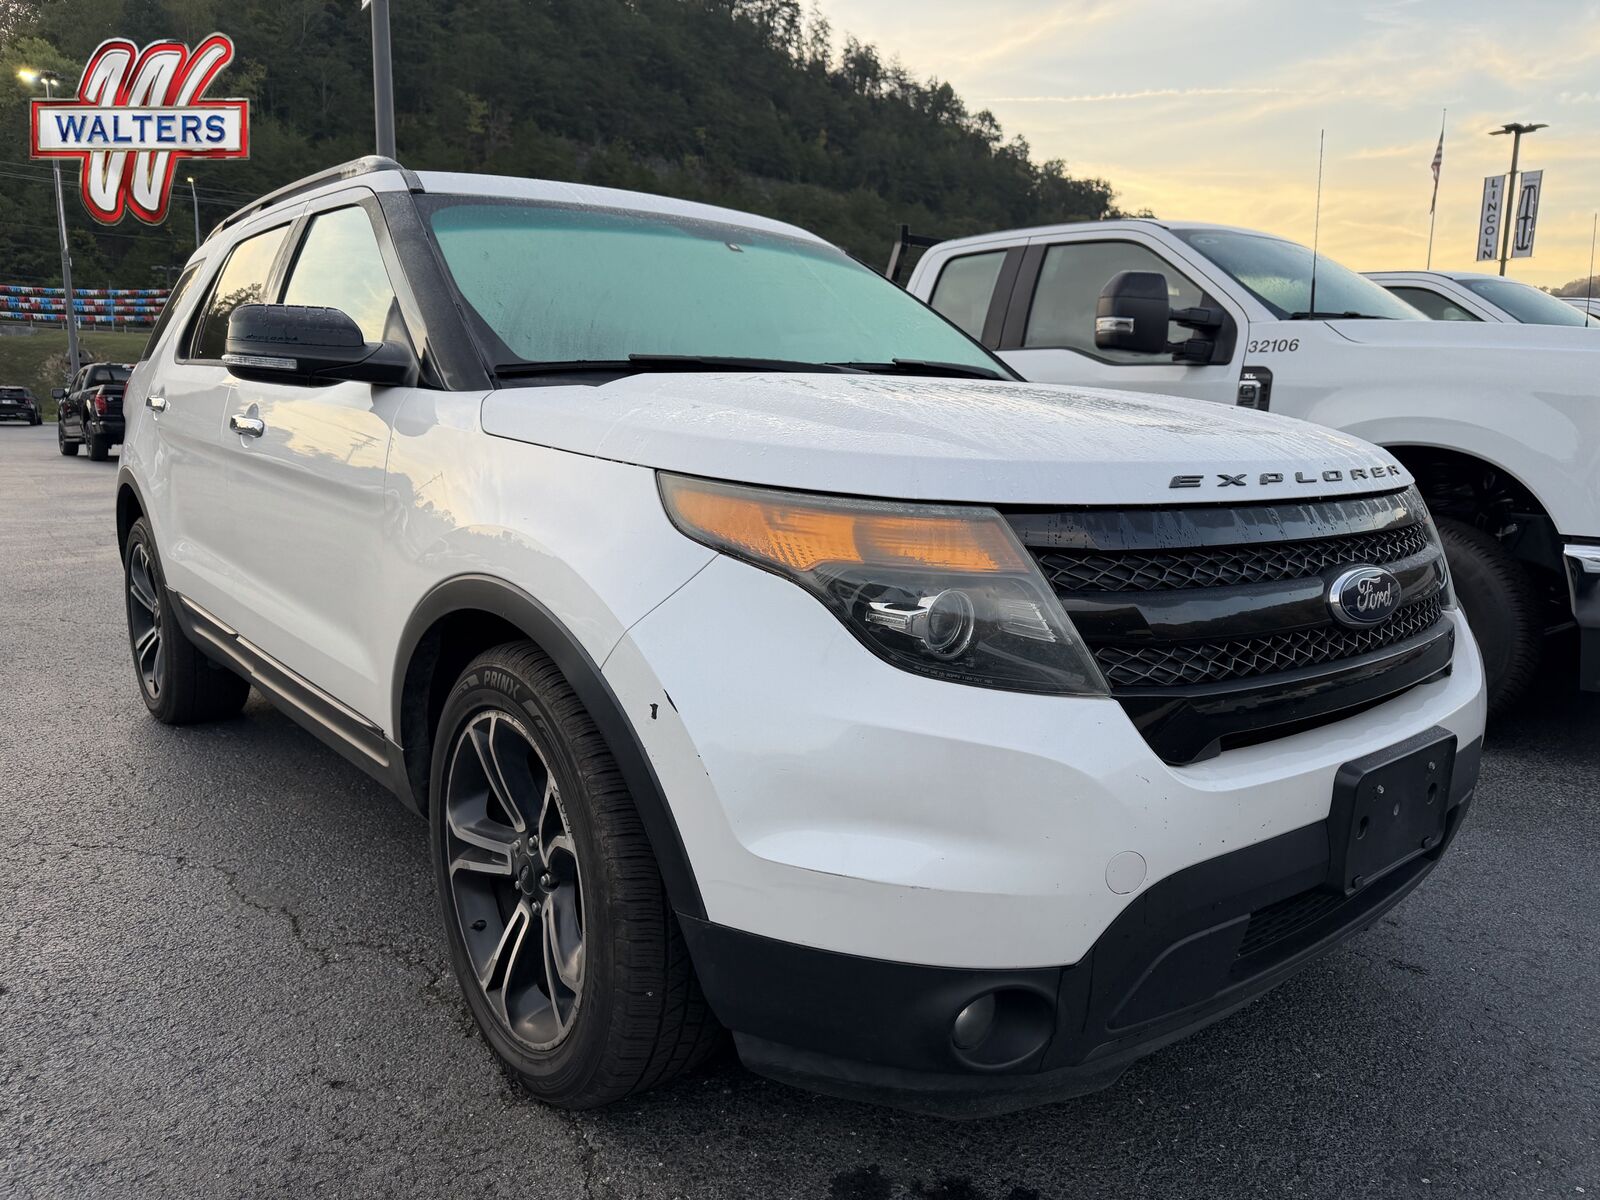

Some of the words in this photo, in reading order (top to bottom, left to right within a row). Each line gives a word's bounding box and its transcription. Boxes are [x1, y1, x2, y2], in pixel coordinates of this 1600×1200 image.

[1483, 179, 1498, 258] LINCOLN
[1248, 338, 1300, 353] 32106
[1169, 464, 1400, 488] EXPLORER
[1356, 576, 1393, 612] Ford
[483, 670, 520, 699] PRINX
